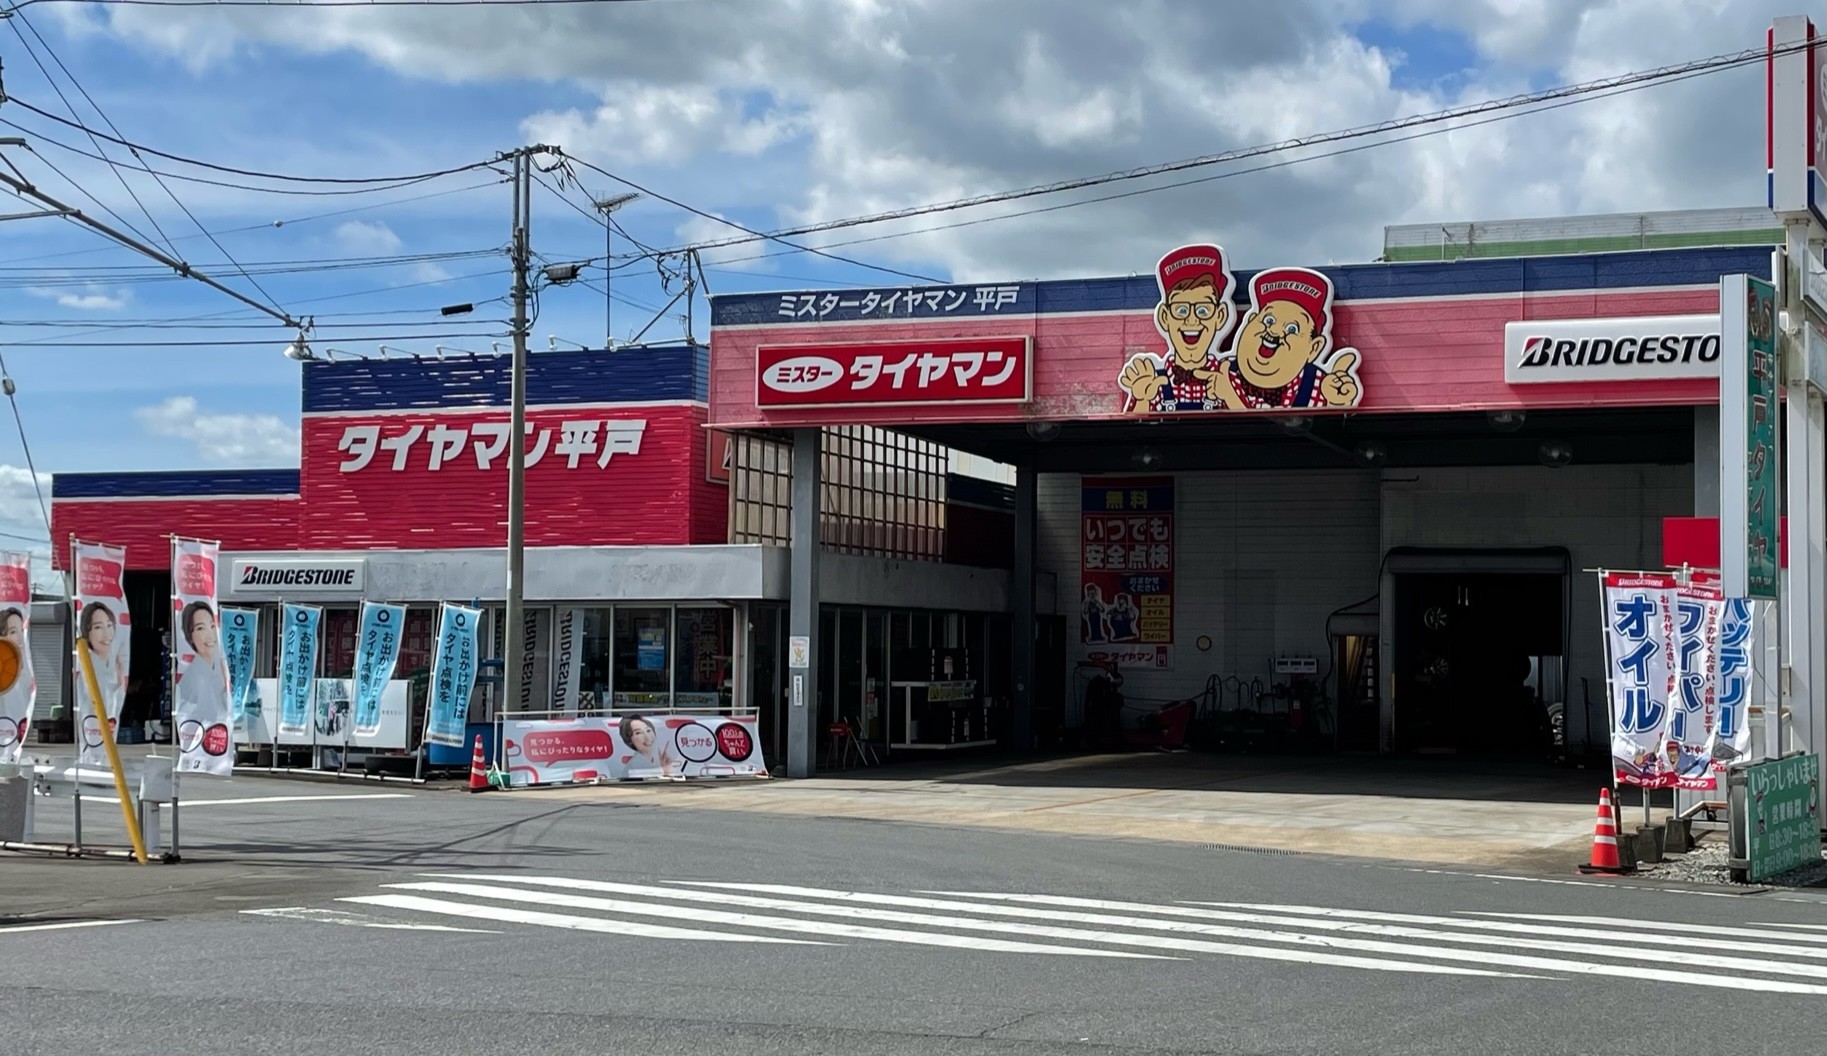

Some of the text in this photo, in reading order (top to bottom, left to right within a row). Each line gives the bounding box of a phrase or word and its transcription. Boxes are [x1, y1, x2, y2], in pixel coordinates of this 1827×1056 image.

[1164, 256, 1217, 277] BRIDGESTONE
[778, 285, 1021, 317] ミスタータイヤマン 平戸
[1260, 281, 1322, 299] BRIDGESTONE
[775, 350, 1017, 391] ミスター タイヤマン
[337, 419, 647, 473] タイヤマン平戸
[1104, 488, 1149, 510] 無料
[1085, 517, 1170, 542] いつでも
[1085, 543, 1170, 570] 安全点検
[240, 566, 356, 585] BRIDGESTONE
[1110, 652, 1154, 662] タイヤマン
[1614, 593, 1665, 732] オイル
[680, 737, 713, 748] 見つかる
[1751, 757, 1818, 798] いらっしゃいませ
